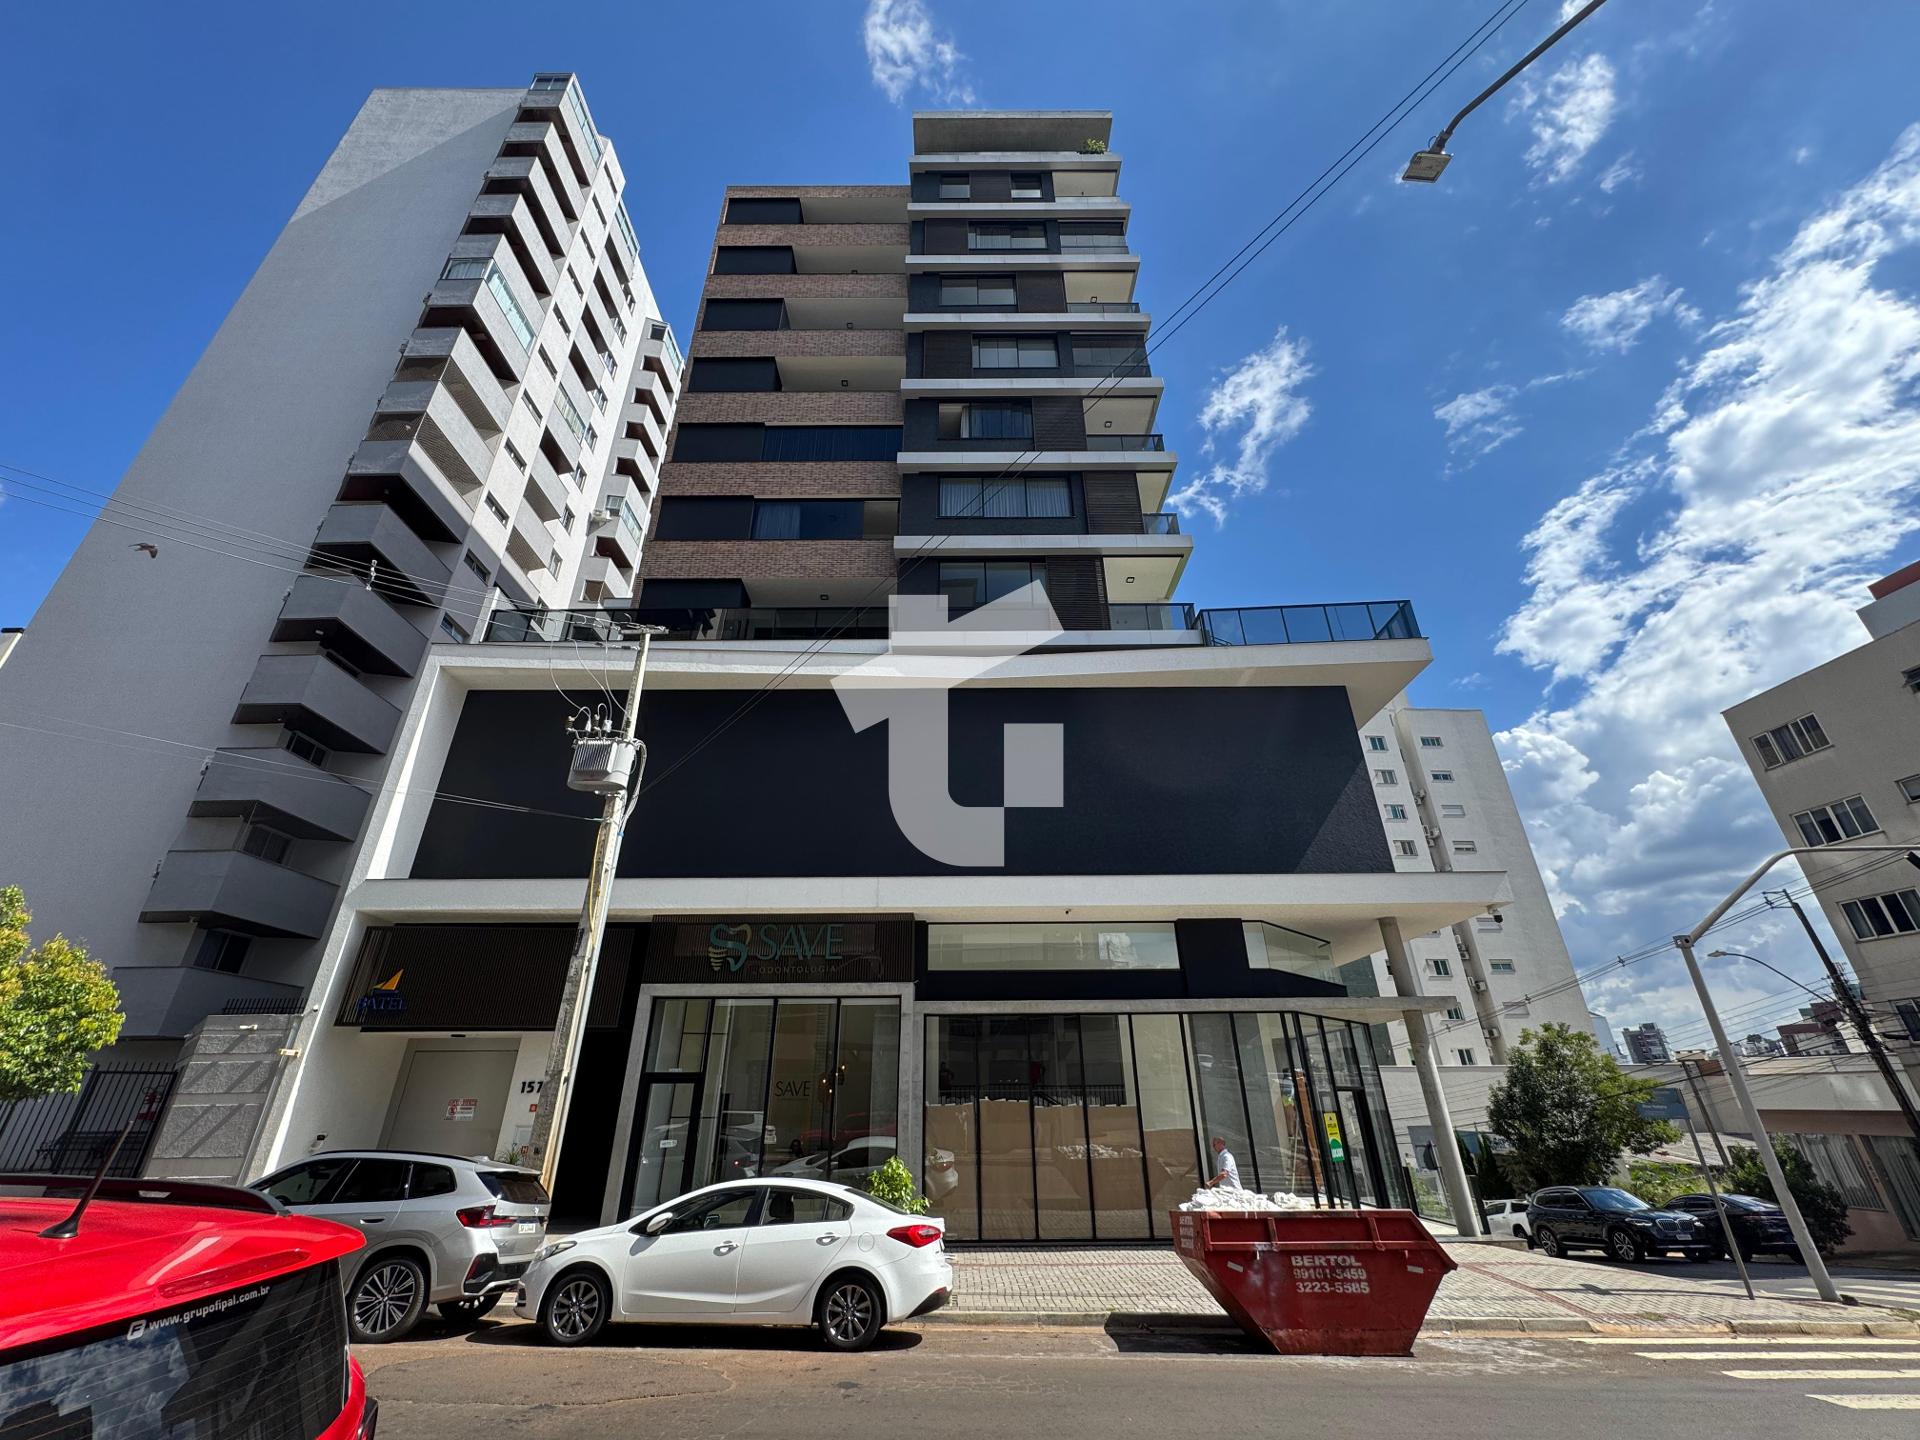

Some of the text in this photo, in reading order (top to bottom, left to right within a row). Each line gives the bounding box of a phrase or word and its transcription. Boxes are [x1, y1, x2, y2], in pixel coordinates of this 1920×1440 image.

[756, 924, 844, 960] SAVE
[759, 966, 836, 974] ODONTOLOGIA
[775, 1080, 812, 1096] SAVE
[1291, 1255, 1361, 1266] BERTOL
[149, 1286, 271, 1330] www.grupofipal.com.br
